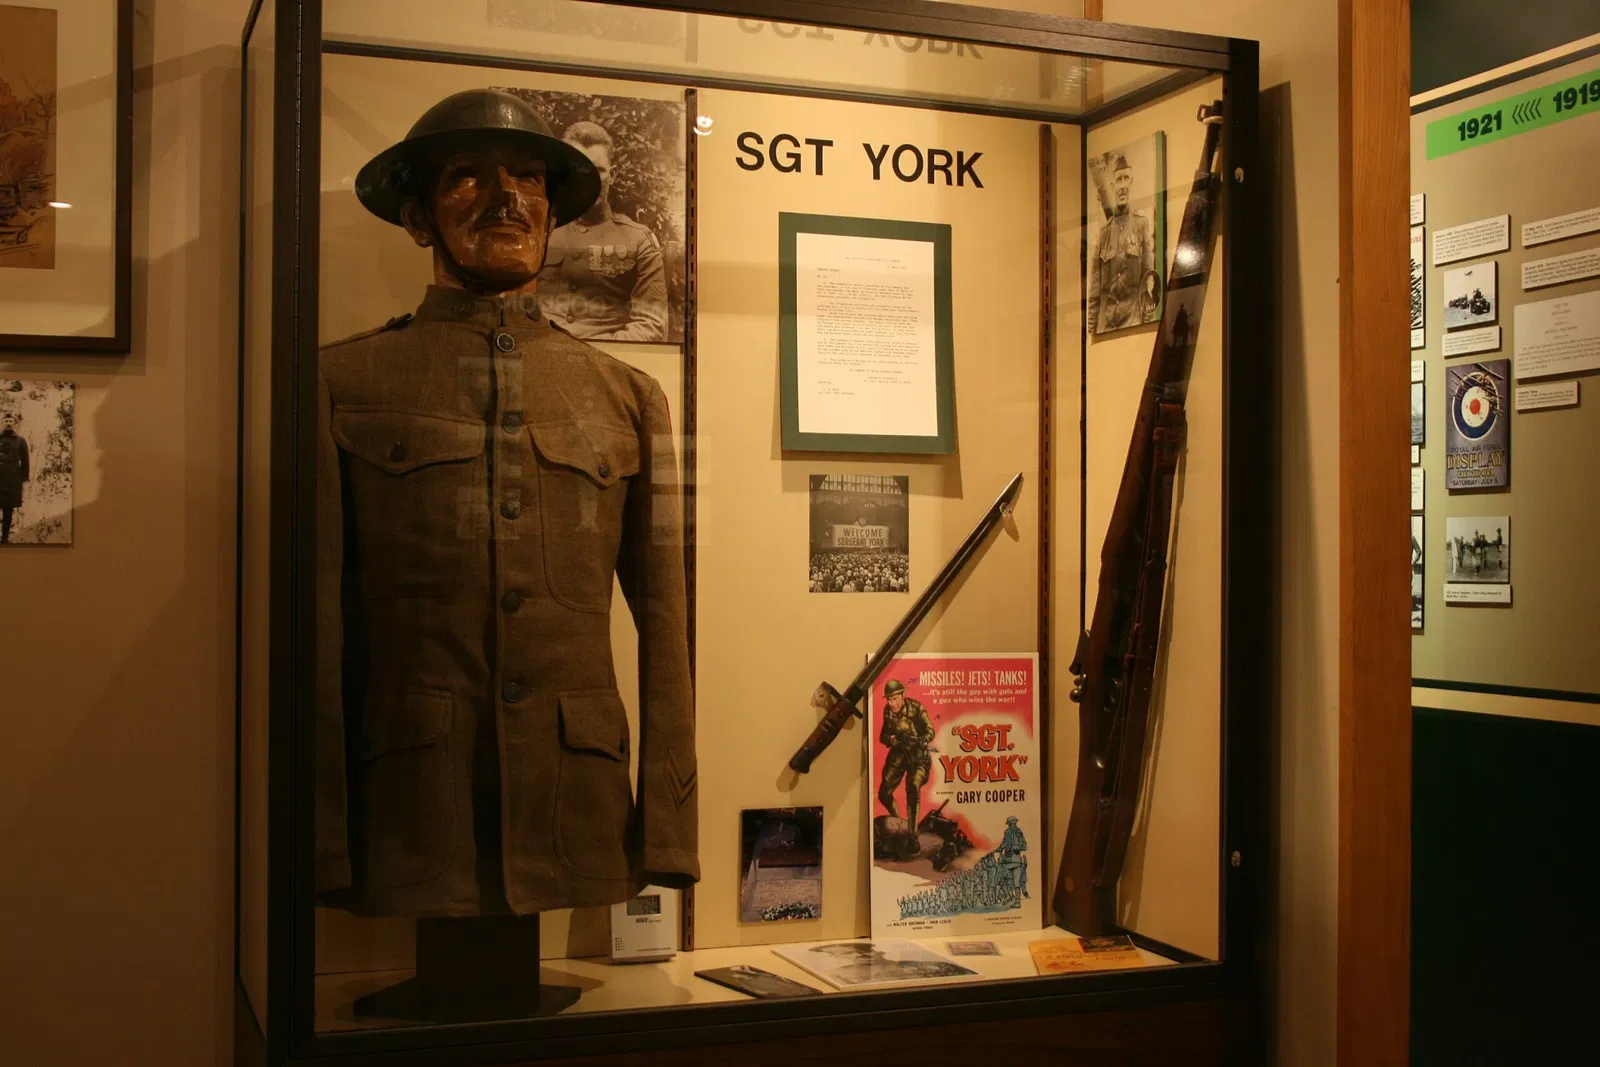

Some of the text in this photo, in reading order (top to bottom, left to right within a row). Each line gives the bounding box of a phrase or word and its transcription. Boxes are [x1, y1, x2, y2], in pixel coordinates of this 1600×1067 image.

[1457, 79, 1600, 142] 1921 1919
[735, 131, 985, 189] SGT YORK
[1446, 450, 1504, 470] DISPLAY
[843, 527, 882, 538] WELCOME
[837, 537, 885, 546] SERGEANT YORK
[919, 670, 1027, 686] MISSILES! JETS! TANKS!
[999, 688, 1012, 696] guts
[1014, 687, 1027, 695] and
[939, 697, 951, 705] gun
[956, 790, 982, 804] GARY
[985, 788, 1025, 803] COOPER
